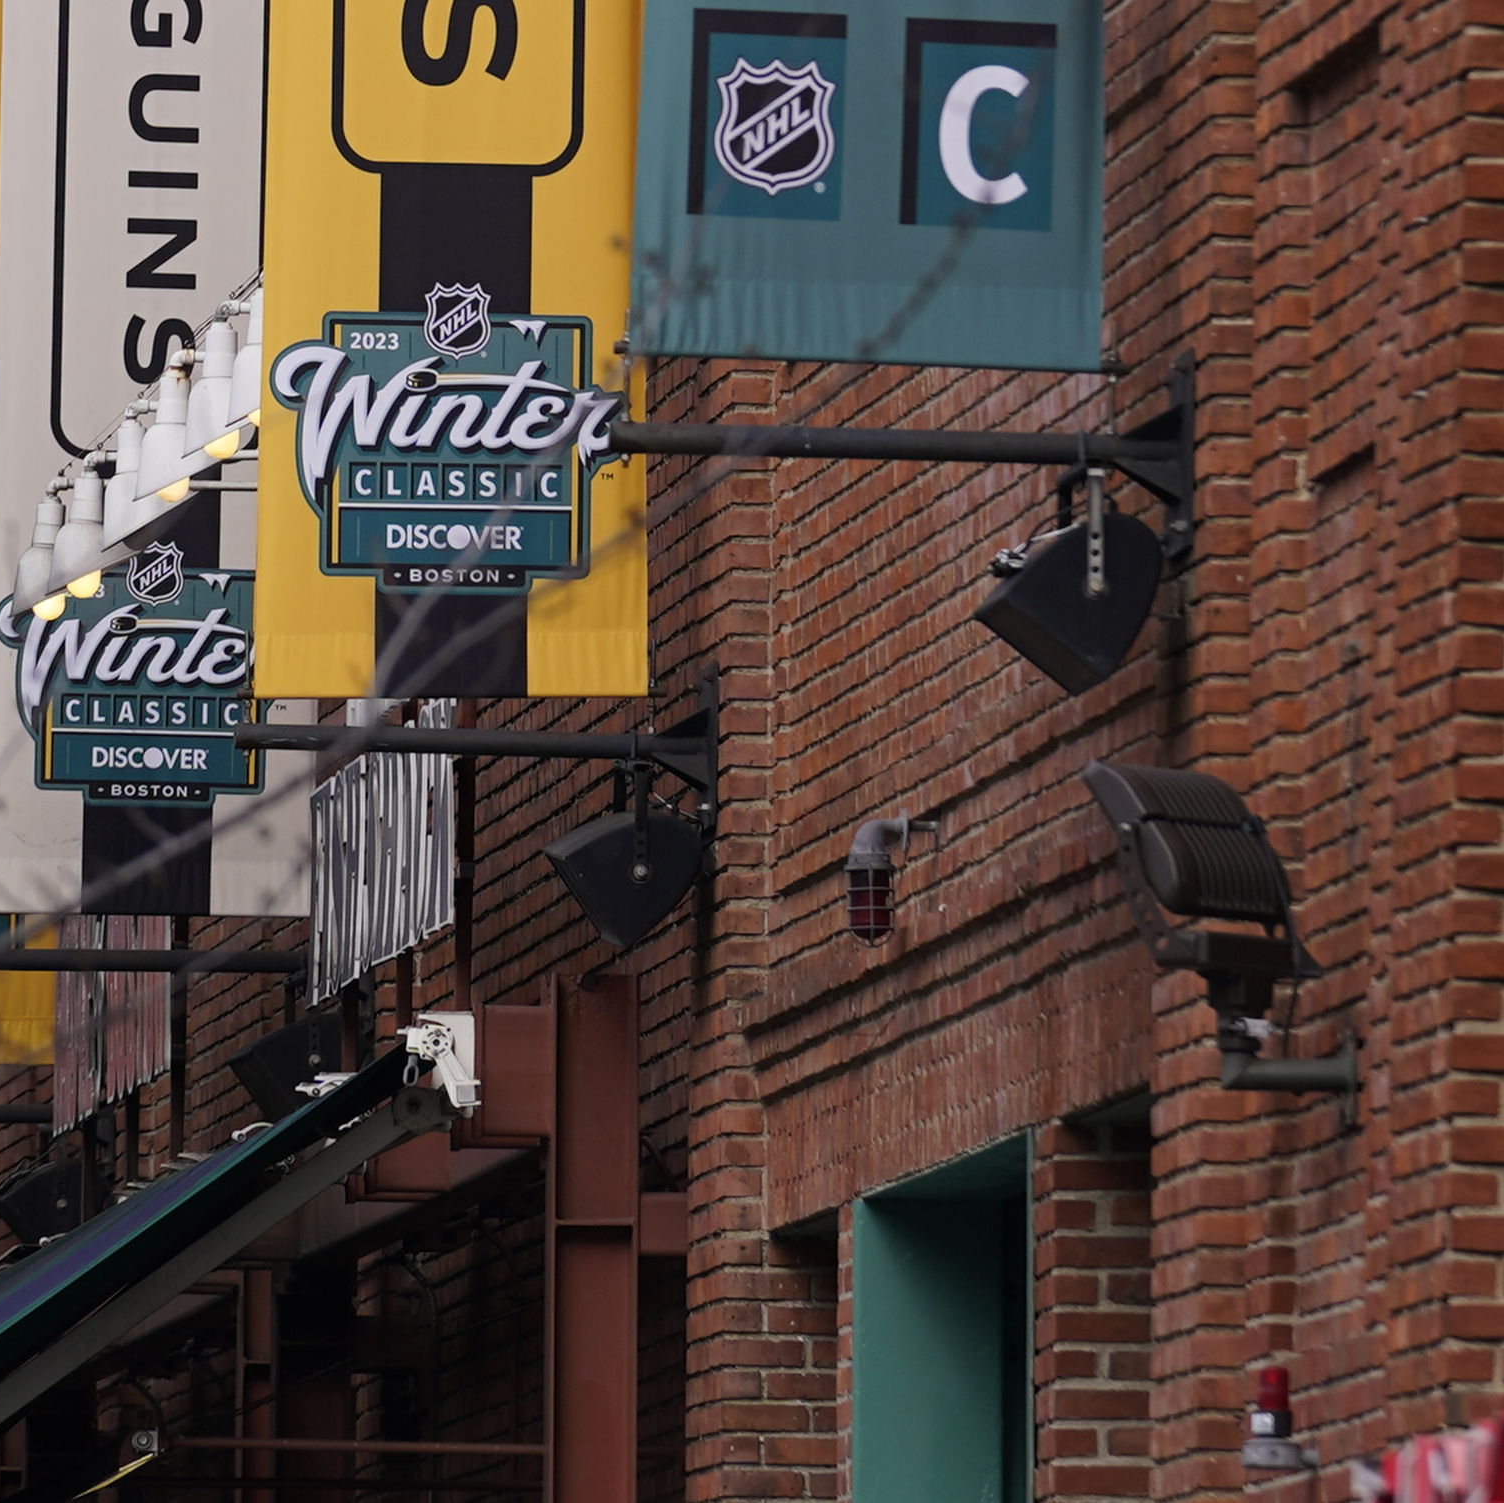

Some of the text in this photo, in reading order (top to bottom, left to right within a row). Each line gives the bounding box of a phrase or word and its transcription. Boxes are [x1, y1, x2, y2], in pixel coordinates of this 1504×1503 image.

[741, 97, 811, 162] NHL
[439, 303, 478, 342] NHL
[350, 332, 400, 350] 2023
[274, 345, 620, 501] Winter
[354, 469, 558, 498] CLASSIC
[386, 524, 523, 550] DISCOVER
[139, 558, 173, 591] NHL
[409, 569, 500, 583] BOSTON
[64, 699, 239, 725] CLASSIC
[92, 746, 208, 770] DISCOVER
[110, 784, 188, 797] BOSTON
